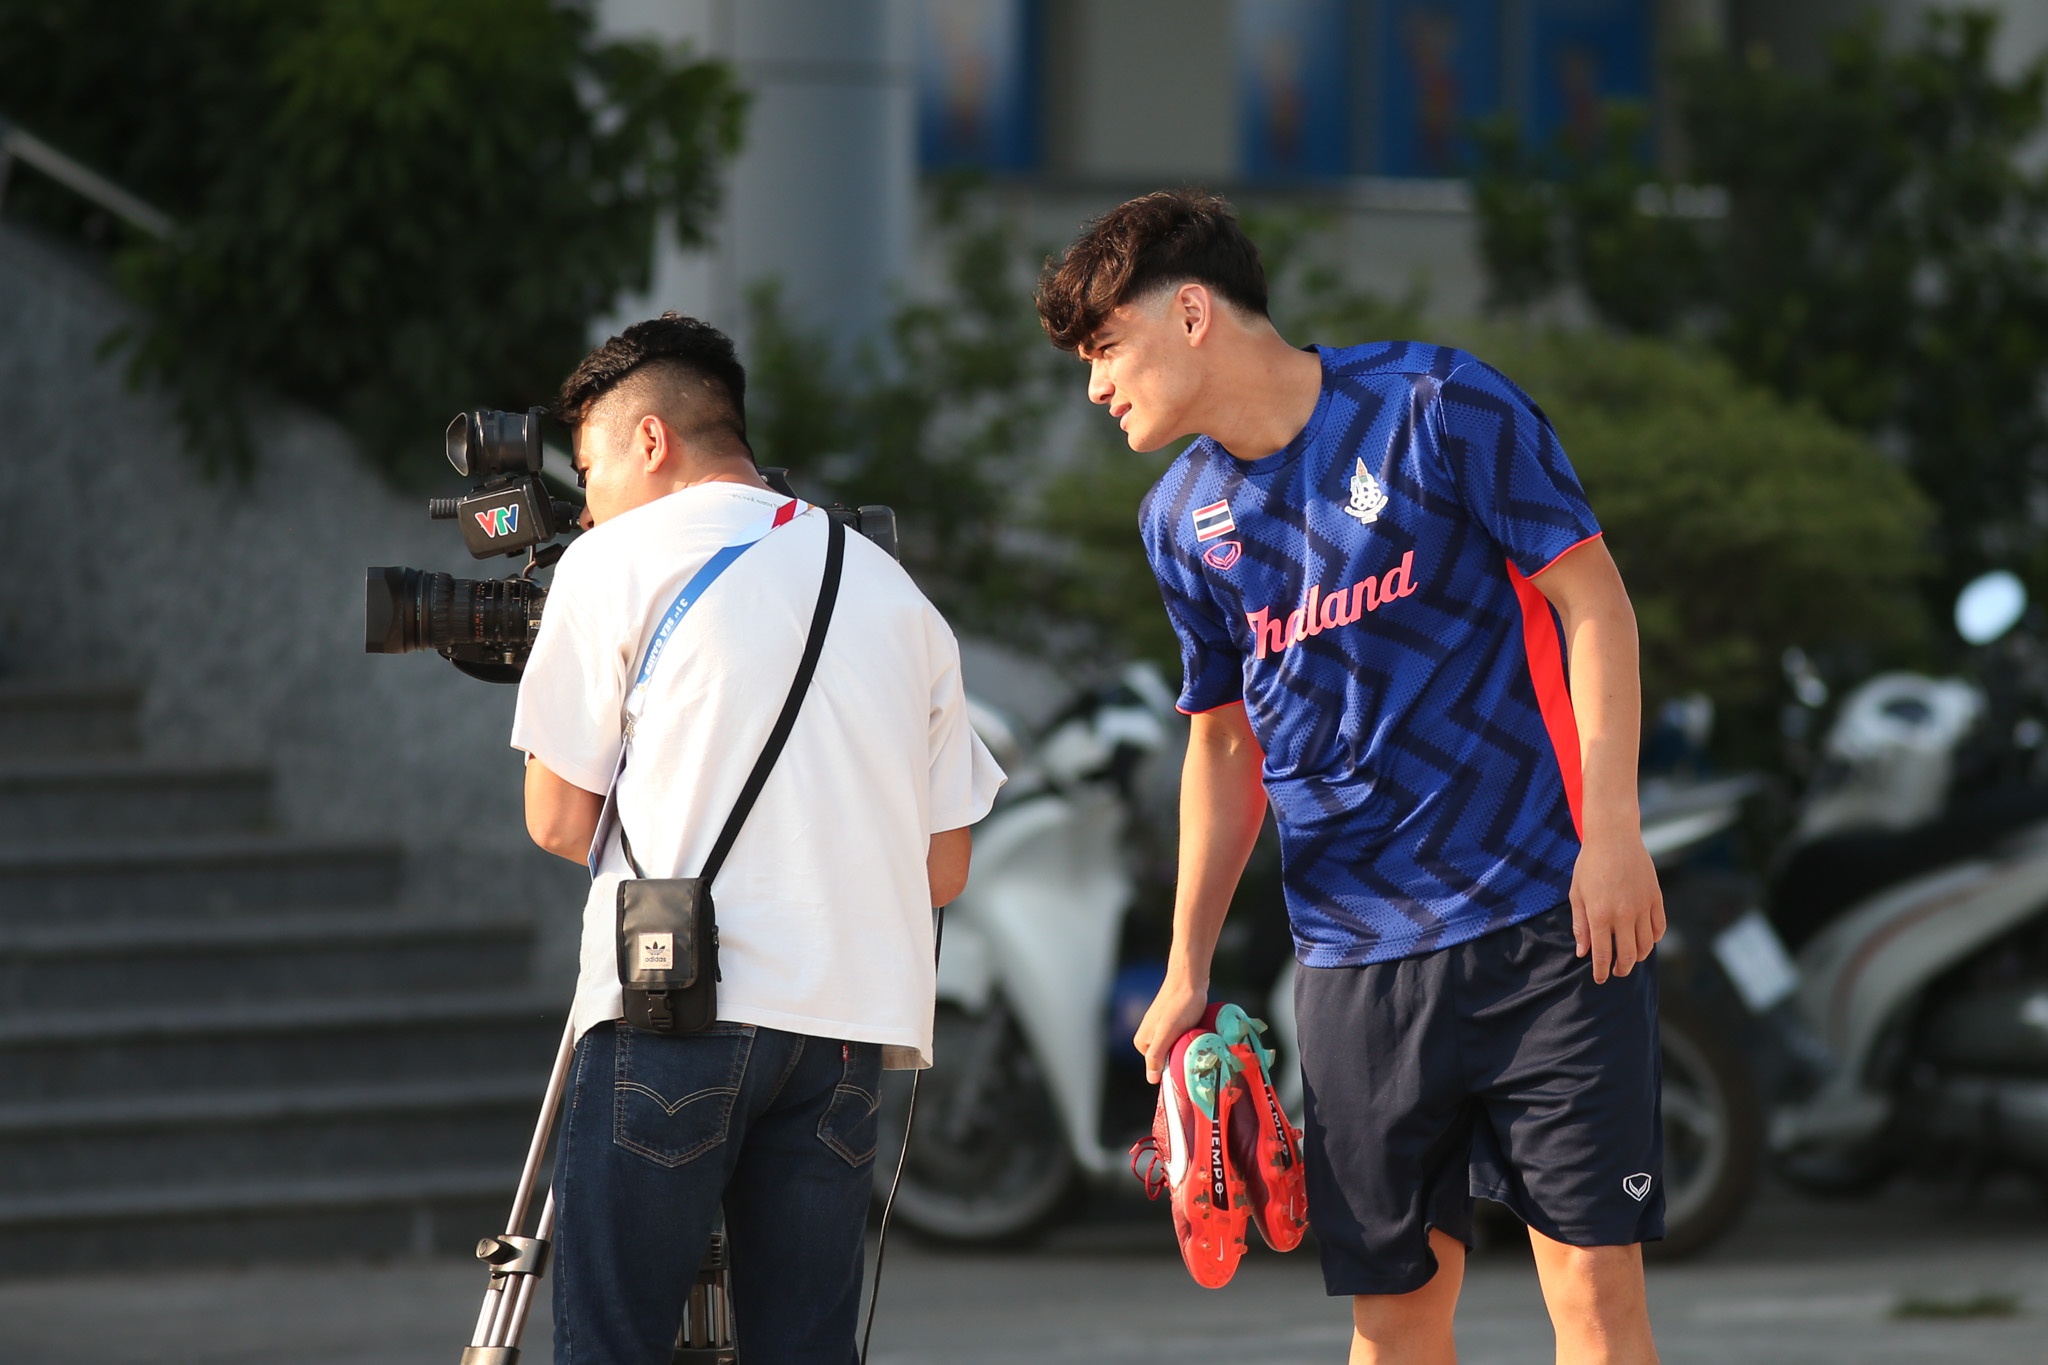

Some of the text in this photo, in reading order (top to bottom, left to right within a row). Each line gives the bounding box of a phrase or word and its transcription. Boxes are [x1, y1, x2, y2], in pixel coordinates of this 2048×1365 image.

[475, 504, 519, 538] VTV
[660, 617, 675, 637] SEA
[1212, 1119, 1224, 1194] TIEMPO
